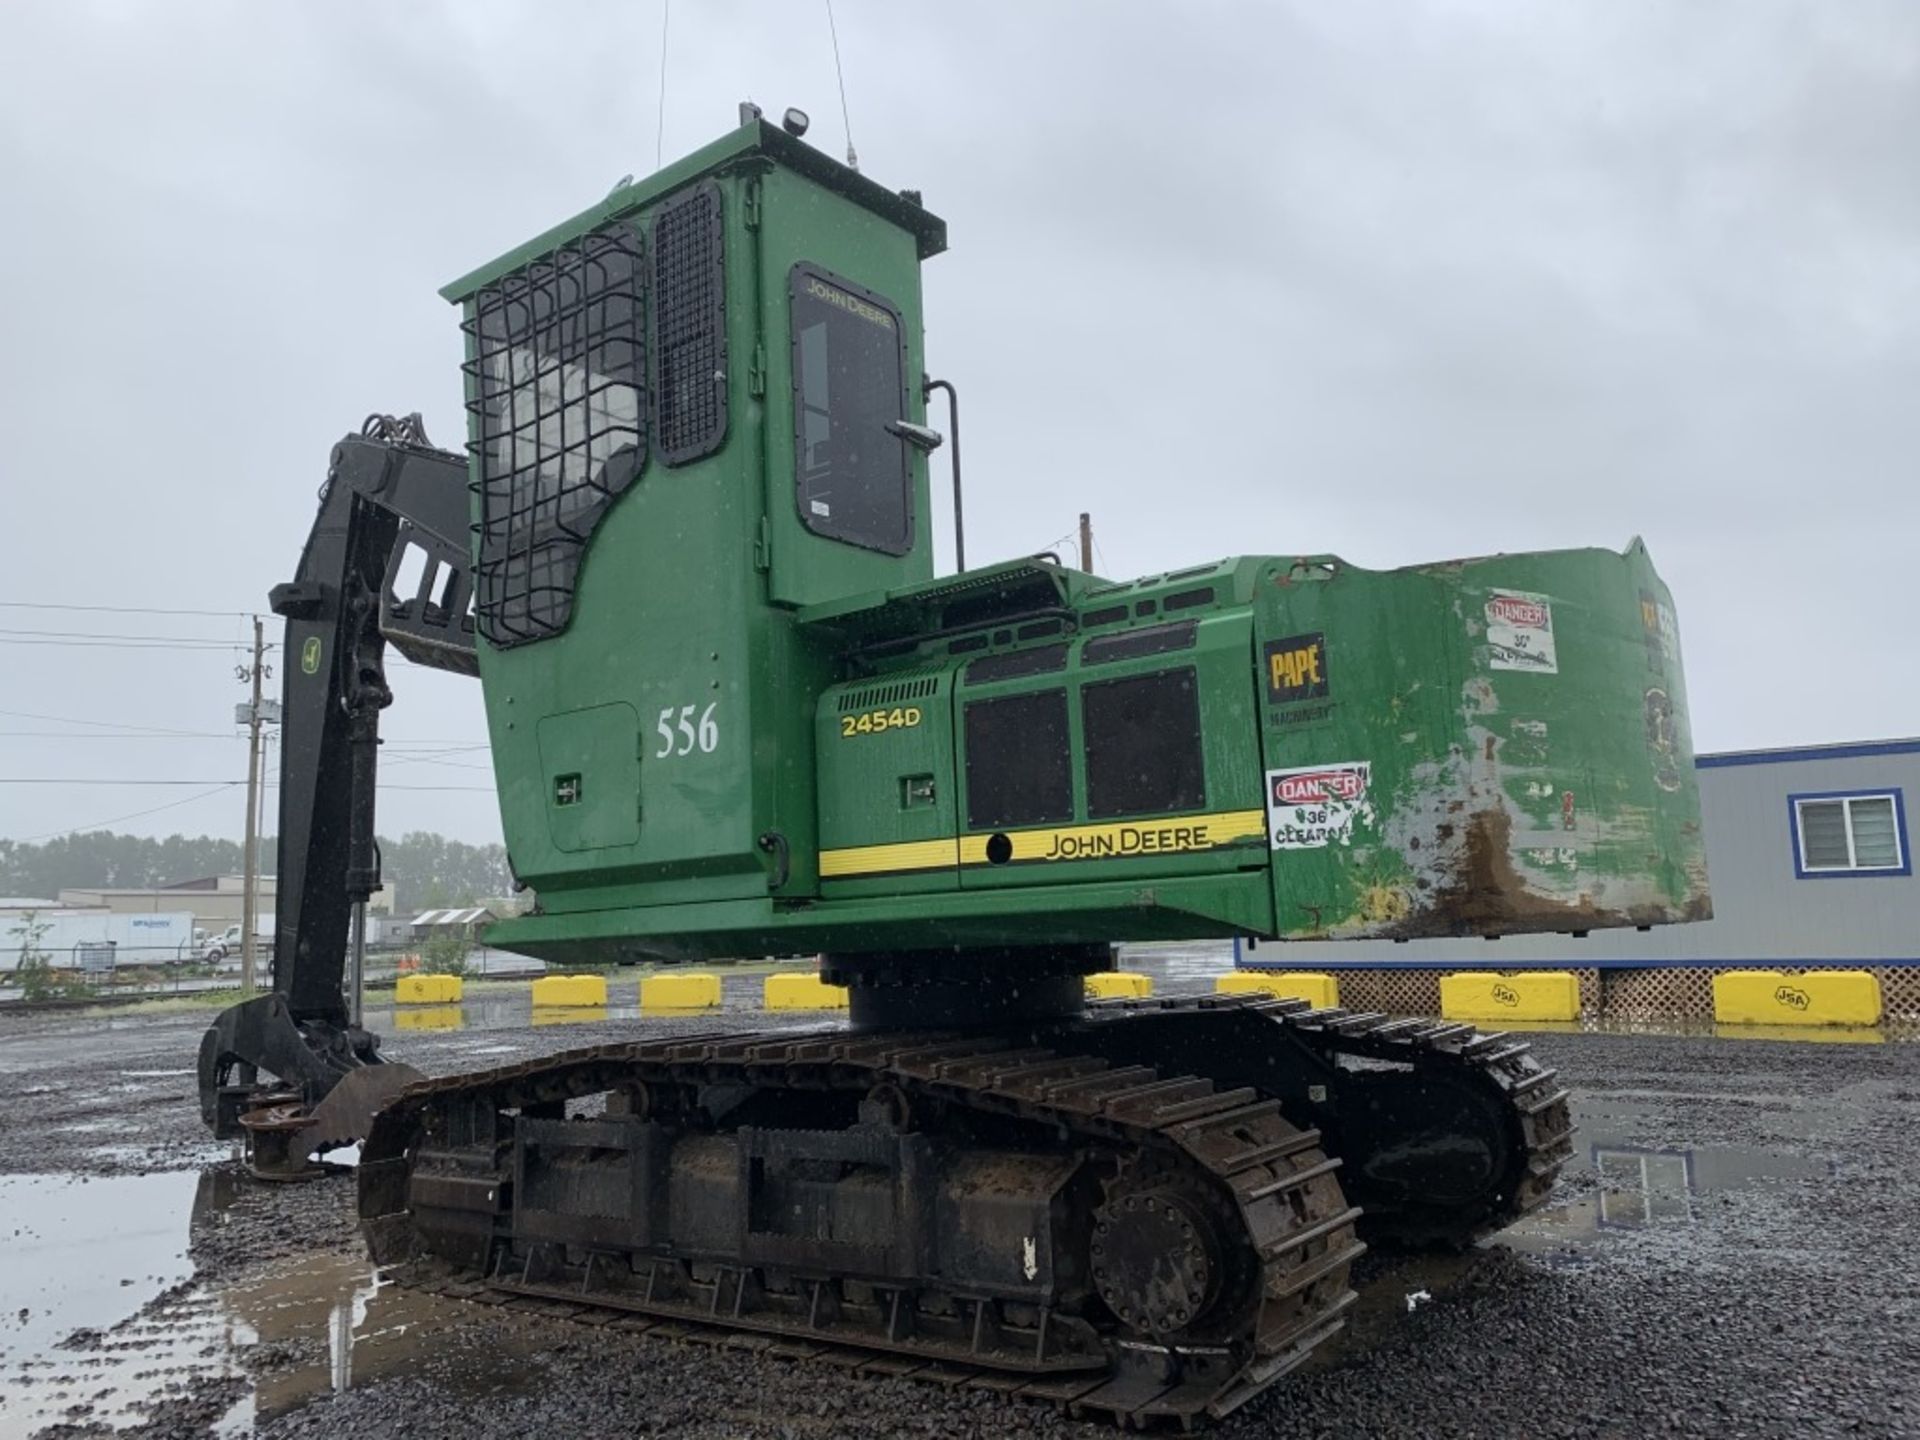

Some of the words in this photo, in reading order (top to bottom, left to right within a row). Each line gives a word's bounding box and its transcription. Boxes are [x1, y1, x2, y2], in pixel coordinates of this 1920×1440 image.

[807, 279, 847, 308] JOHN
[847, 295, 892, 329] DEERE
[656, 702, 718, 758] 556
[841, 708, 920, 737] 2454D
[1046, 834, 1113, 857] JOHN
[1120, 826, 1208, 851] DEERE
[1779, 989, 1805, 1006] JSA
